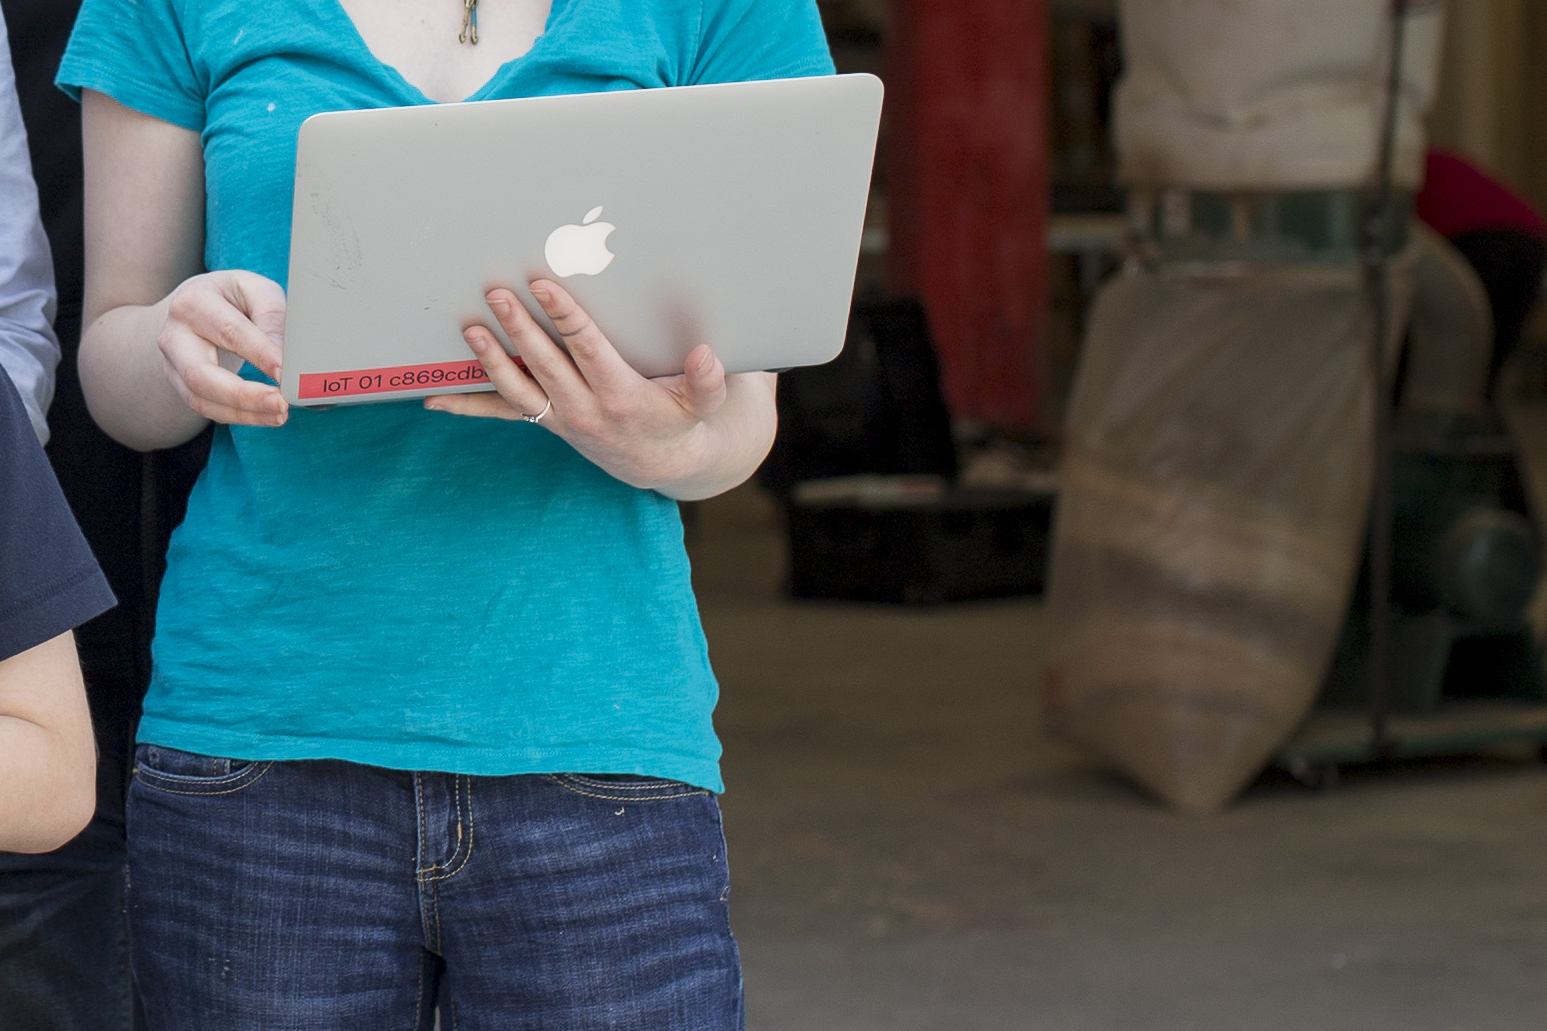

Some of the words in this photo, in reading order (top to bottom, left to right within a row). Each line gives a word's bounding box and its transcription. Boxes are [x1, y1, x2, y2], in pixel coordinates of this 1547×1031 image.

[322, 377, 353, 393] IoT
[358, 375, 383, 390] 01
[389, 365, 489, 388] c869cdb
